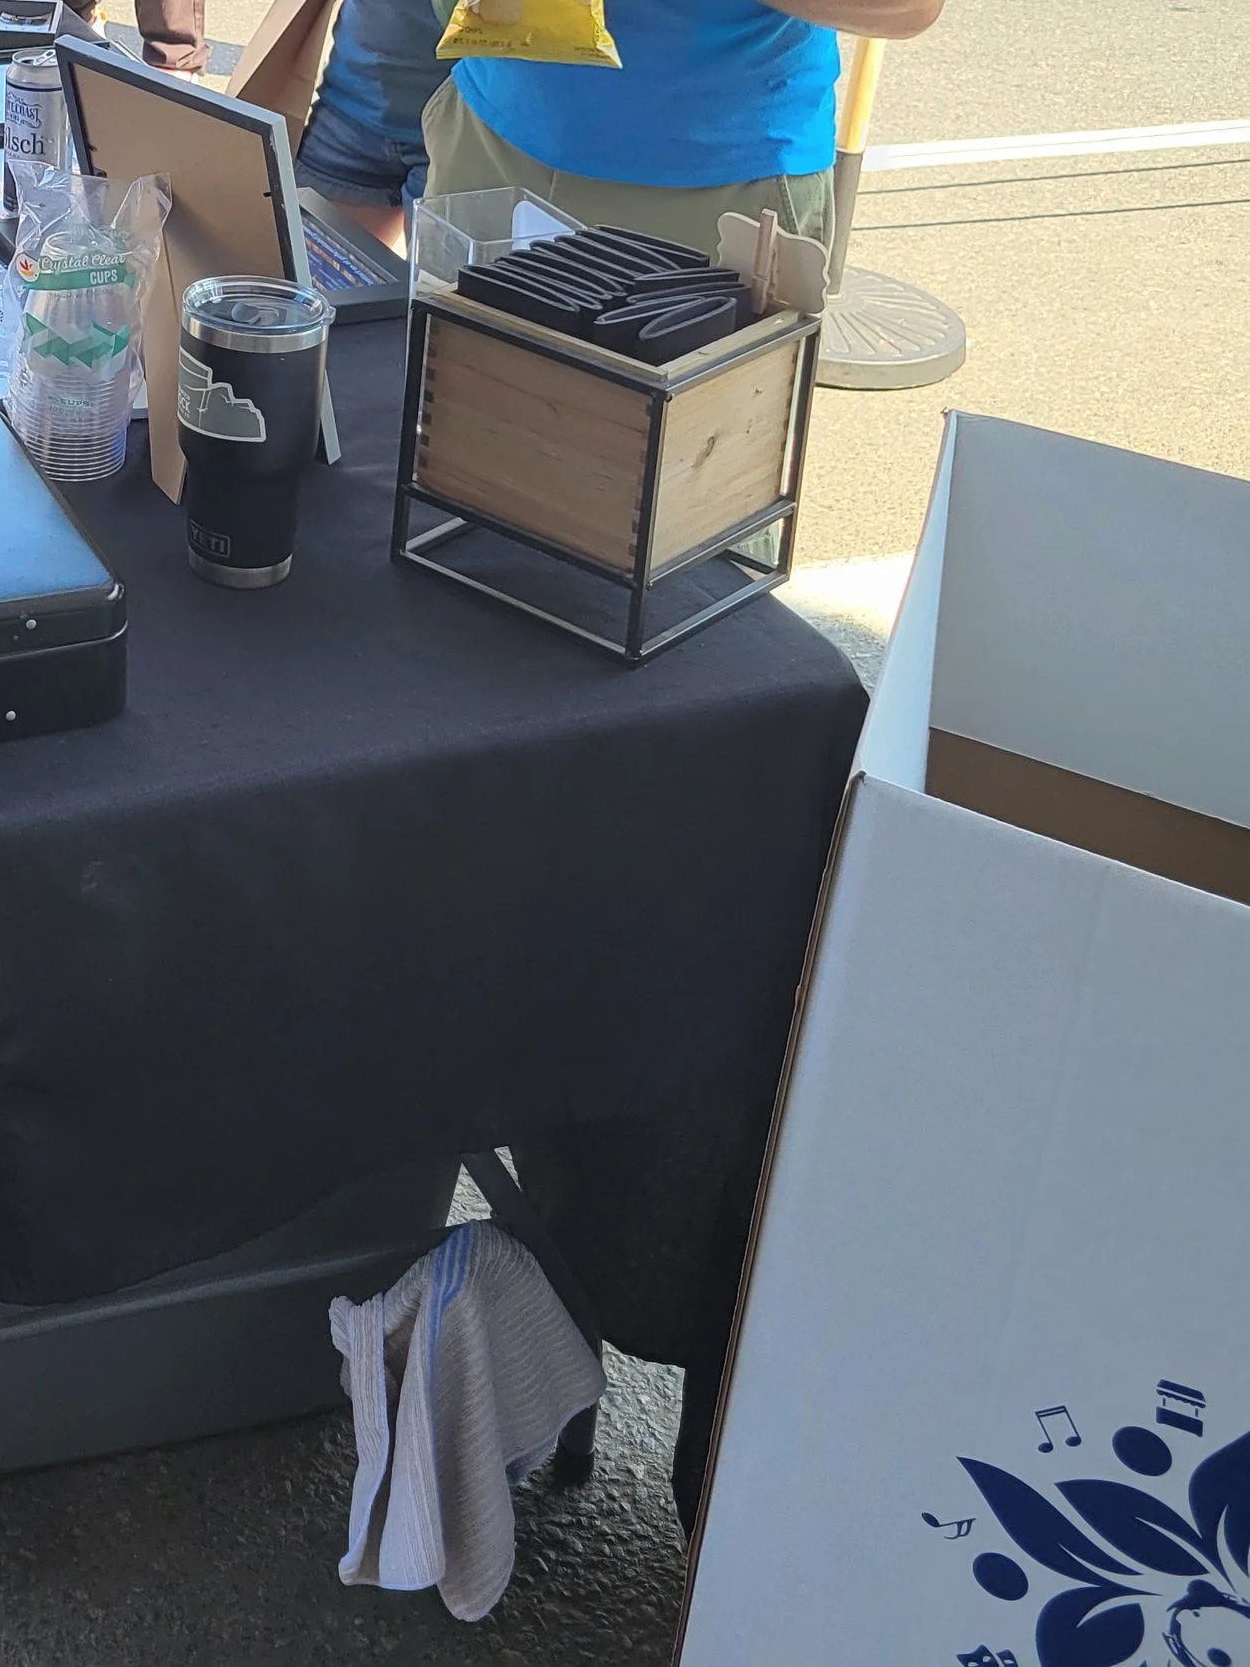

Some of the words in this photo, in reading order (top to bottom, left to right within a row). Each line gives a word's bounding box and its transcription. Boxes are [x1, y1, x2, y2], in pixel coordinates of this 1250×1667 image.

[39, 254, 88, 276] Crystal
[91, 253, 126, 266] Clear
[90, 269, 118, 285] CUPS
[190, 524, 227, 554] YETI
